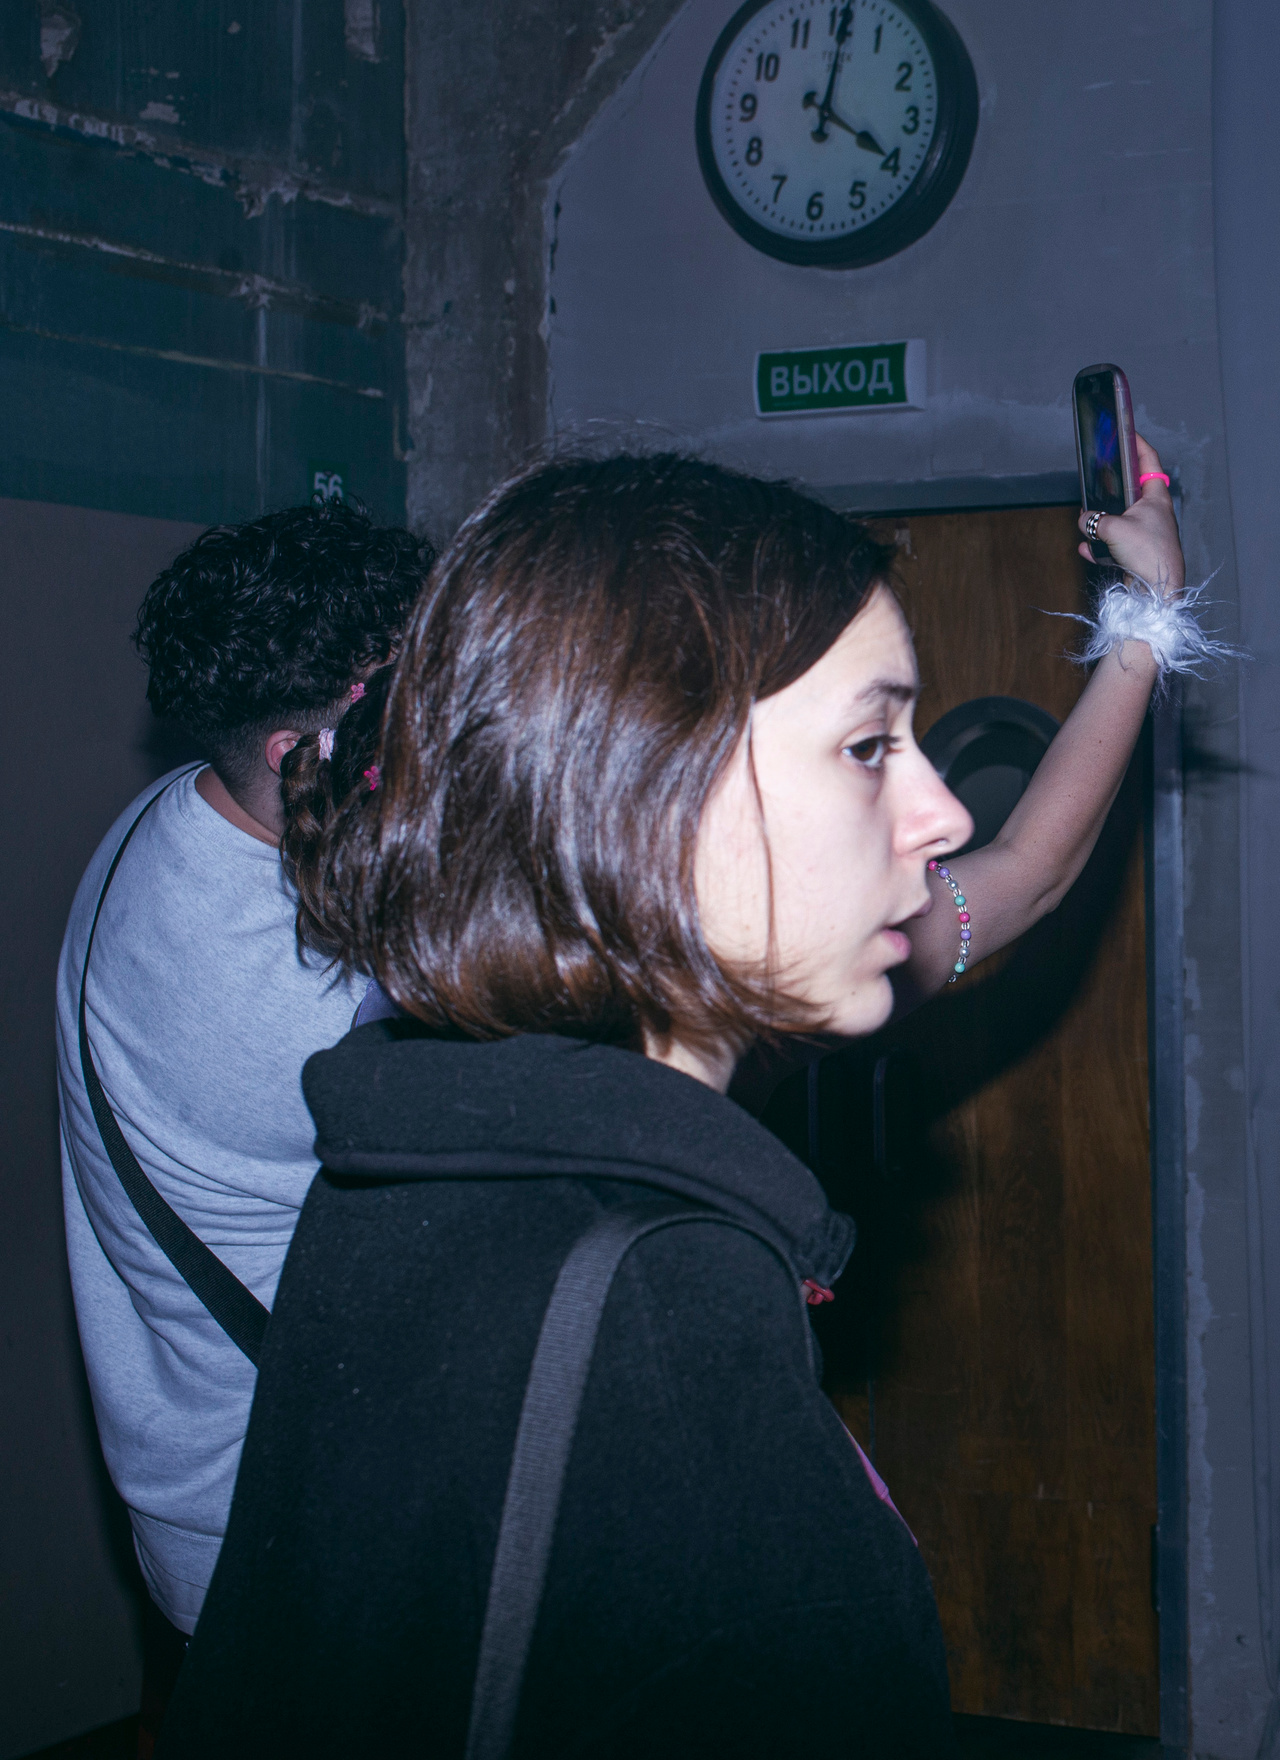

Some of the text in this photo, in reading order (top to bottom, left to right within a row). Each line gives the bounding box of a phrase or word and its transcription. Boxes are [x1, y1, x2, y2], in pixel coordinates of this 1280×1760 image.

[791, 18, 811, 49] 11
[874, 23, 882, 53] 1
[755, 52, 780, 82] 10
[895, 62, 913, 92] 2
[740, 93, 757, 123] 9
[902, 105, 920, 135] 3
[745, 136, 763, 167] 8
[881, 147, 901, 178] 4
[771, 174, 787, 202] 7
[849, 180, 867, 210] 5
[806, 191, 824, 221] 6
[770, 357, 893, 398] ВЫХОД
[313, 471, 343, 504] 56
